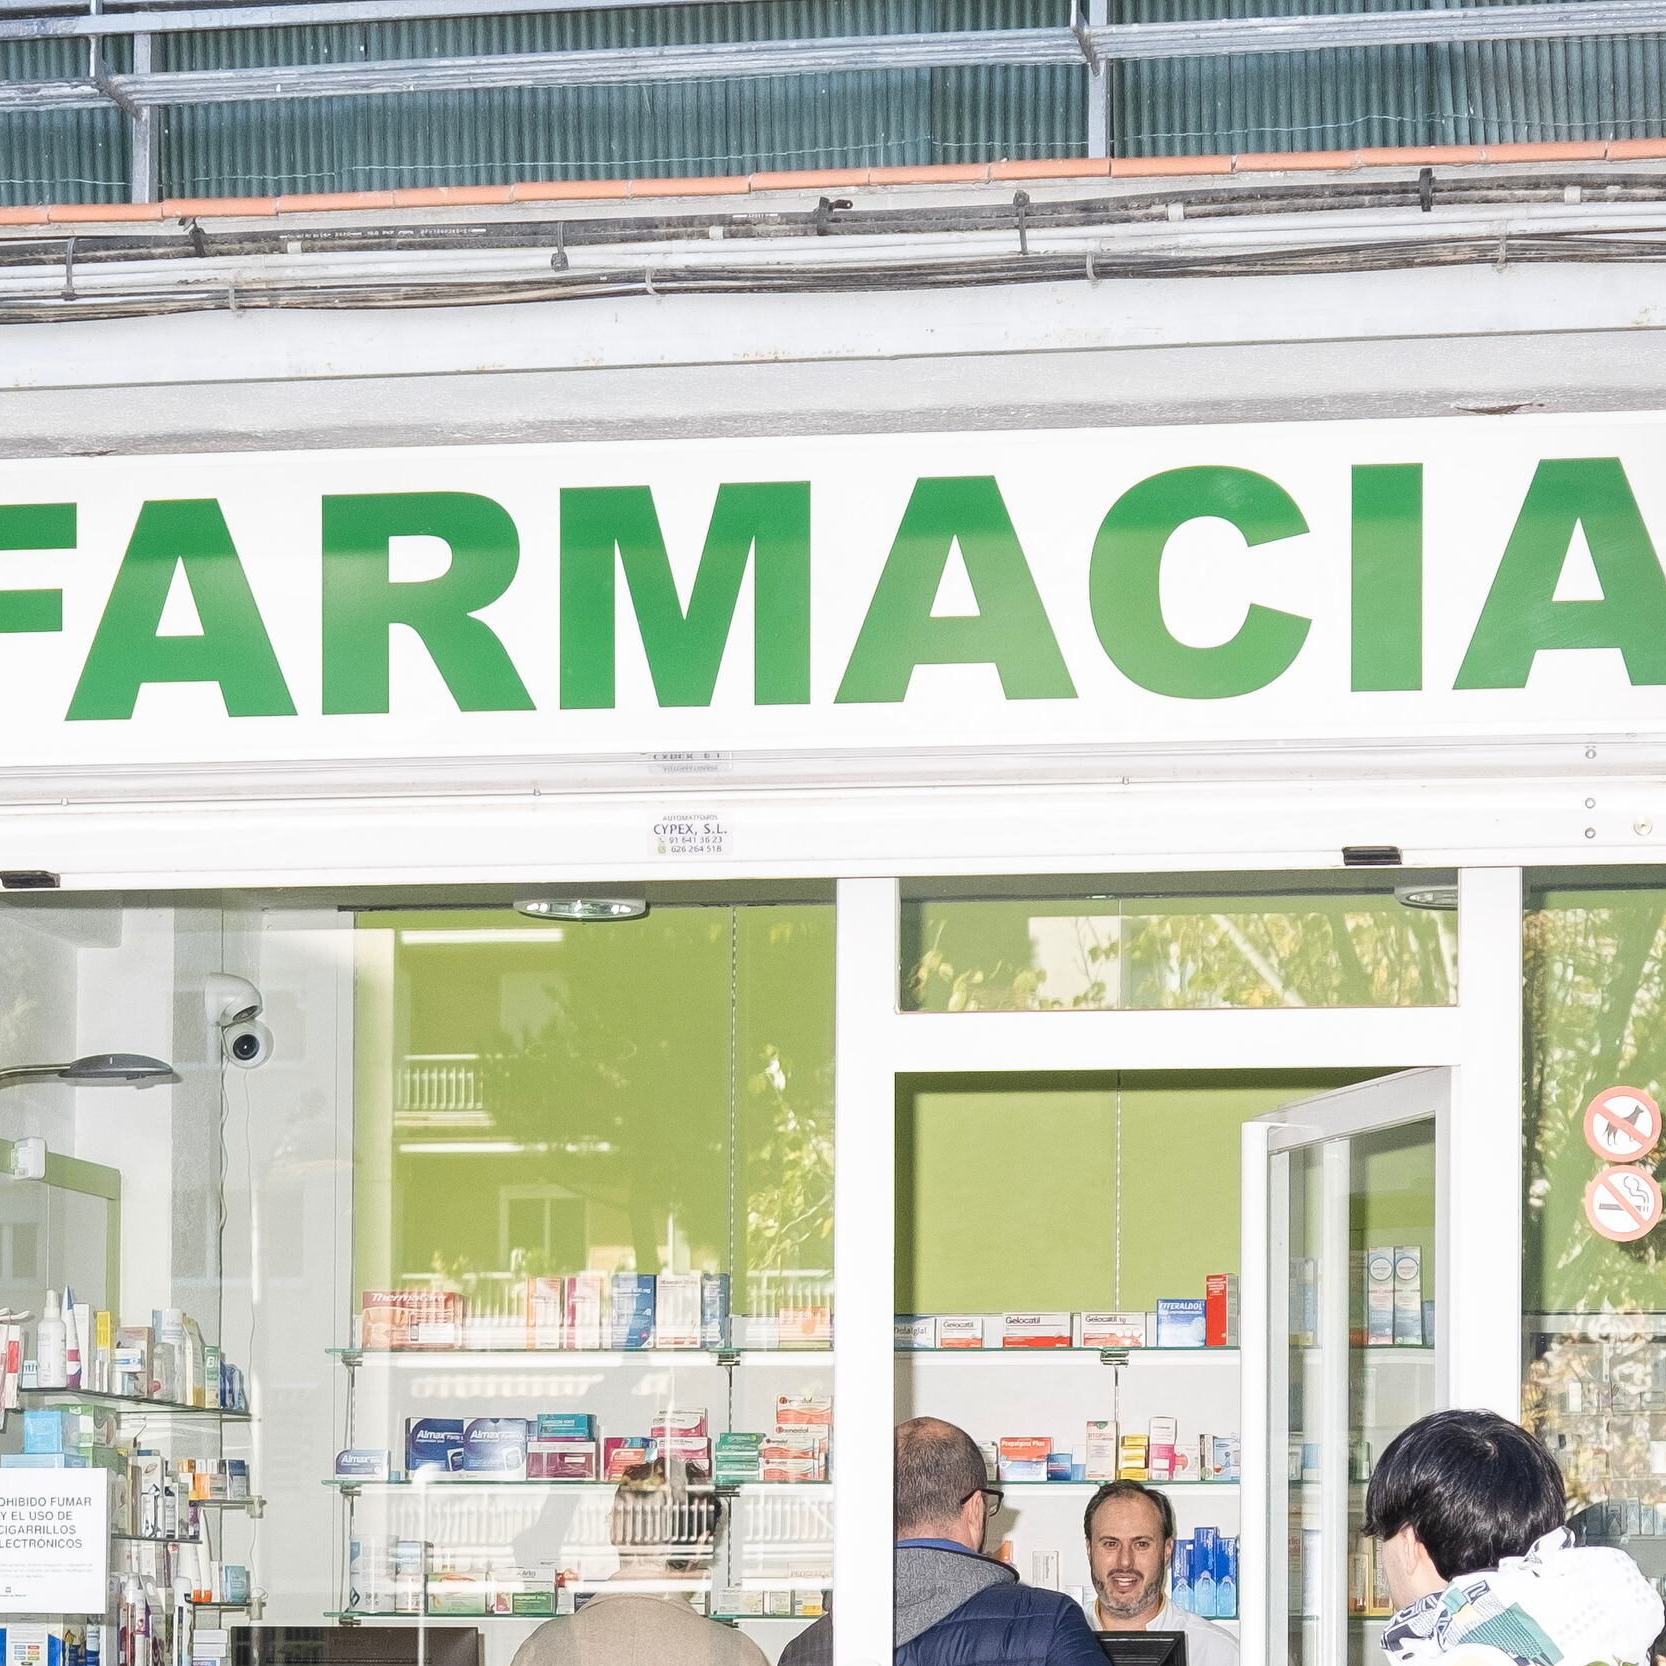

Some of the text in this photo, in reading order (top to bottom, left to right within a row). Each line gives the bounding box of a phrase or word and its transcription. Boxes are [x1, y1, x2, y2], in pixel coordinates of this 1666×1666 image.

[653, 823, 727, 836] CYPEX, S.L.
[1005, 1316, 1041, 1325] Gelocatil
[1085, 1315, 1117, 1323] Gelocatil
[943, 1320, 974, 1329] Gelocatil
[417, 1429, 446, 1439] Almax
[470, 1429, 500, 1439] Almax
[341, 1455, 369, 1463] Almax
[50, 1497, 92, 1507] FUMAR
[0, 1511, 73, 1521] Y EL USO DE
